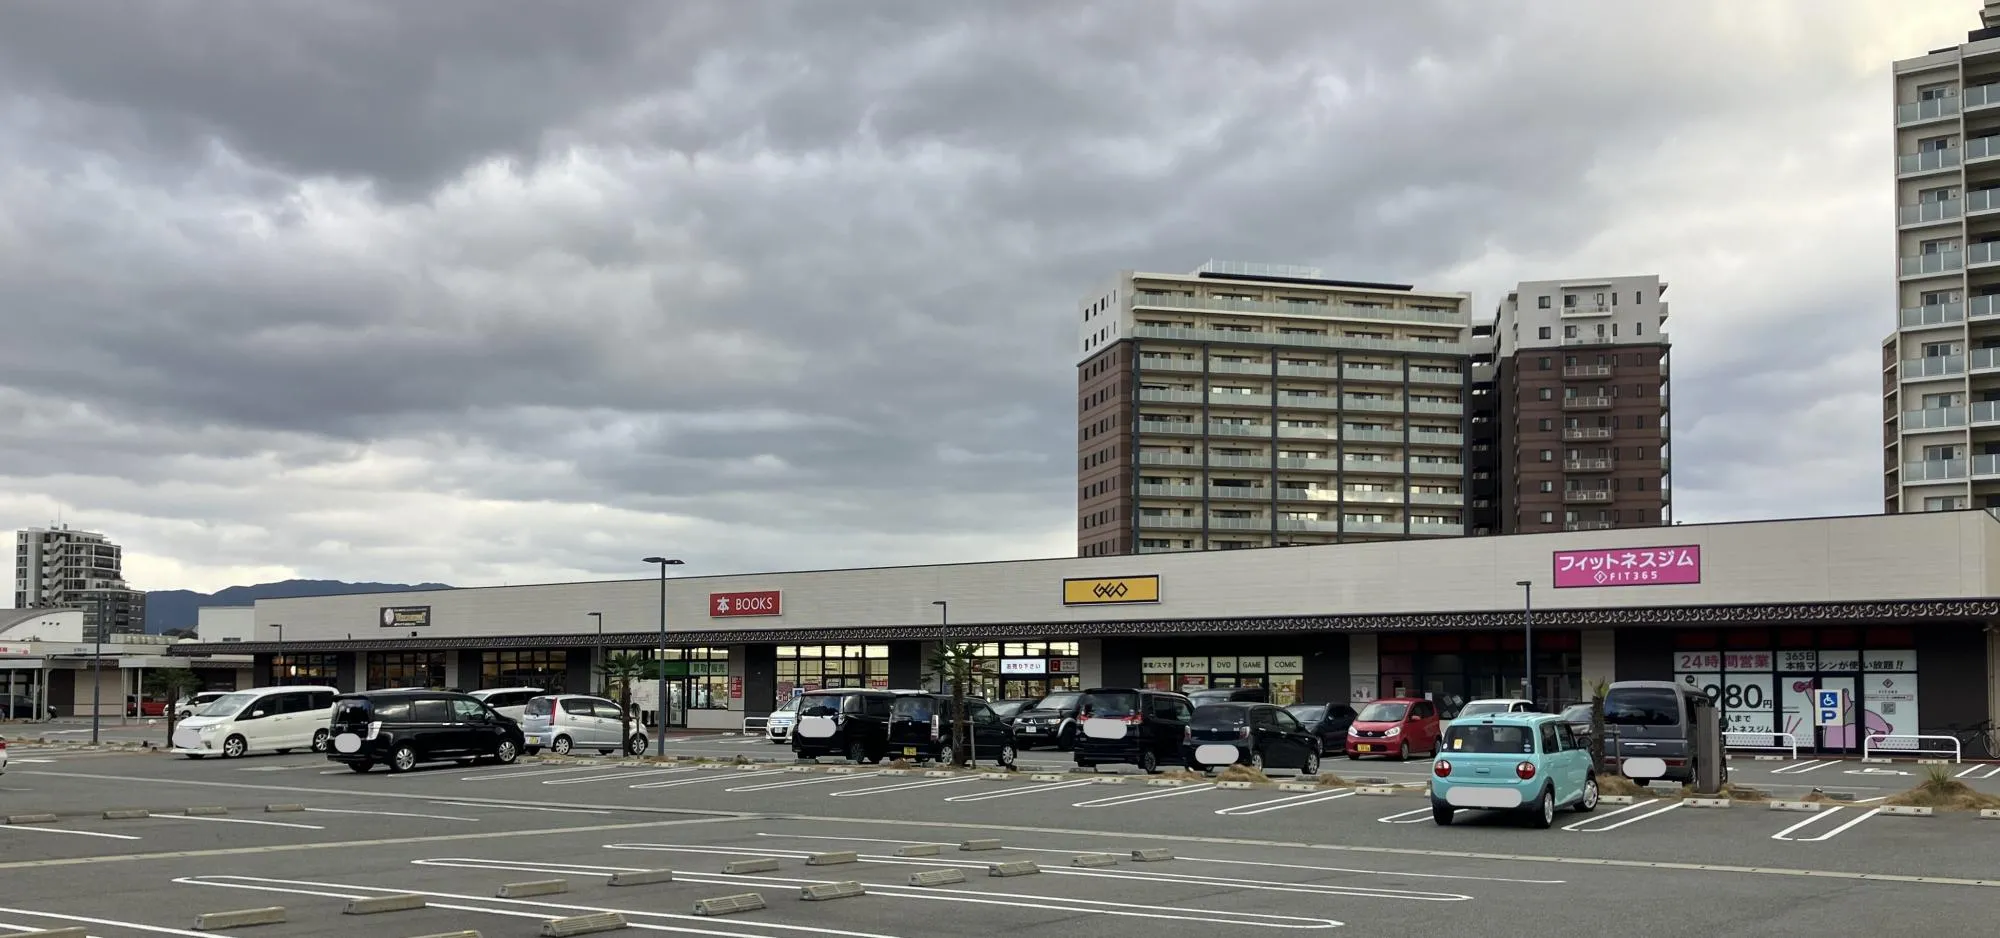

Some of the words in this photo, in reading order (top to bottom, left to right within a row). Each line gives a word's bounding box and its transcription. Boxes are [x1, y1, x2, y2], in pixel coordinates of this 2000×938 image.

[1559, 550, 1694, 571] フィットネスジム
[1610, 571, 1658, 581] FIT365
[1093, 582, 1128, 598] GEO
[717, 597, 730, 613] 本
[735, 597, 773, 610] BOOKS
[1681, 654, 1769, 668] 24時間営業
[1785, 652, 1815, 660] 365日
[1274, 660, 1297, 668] COMIC
[1822, 710, 1836, 724] P
